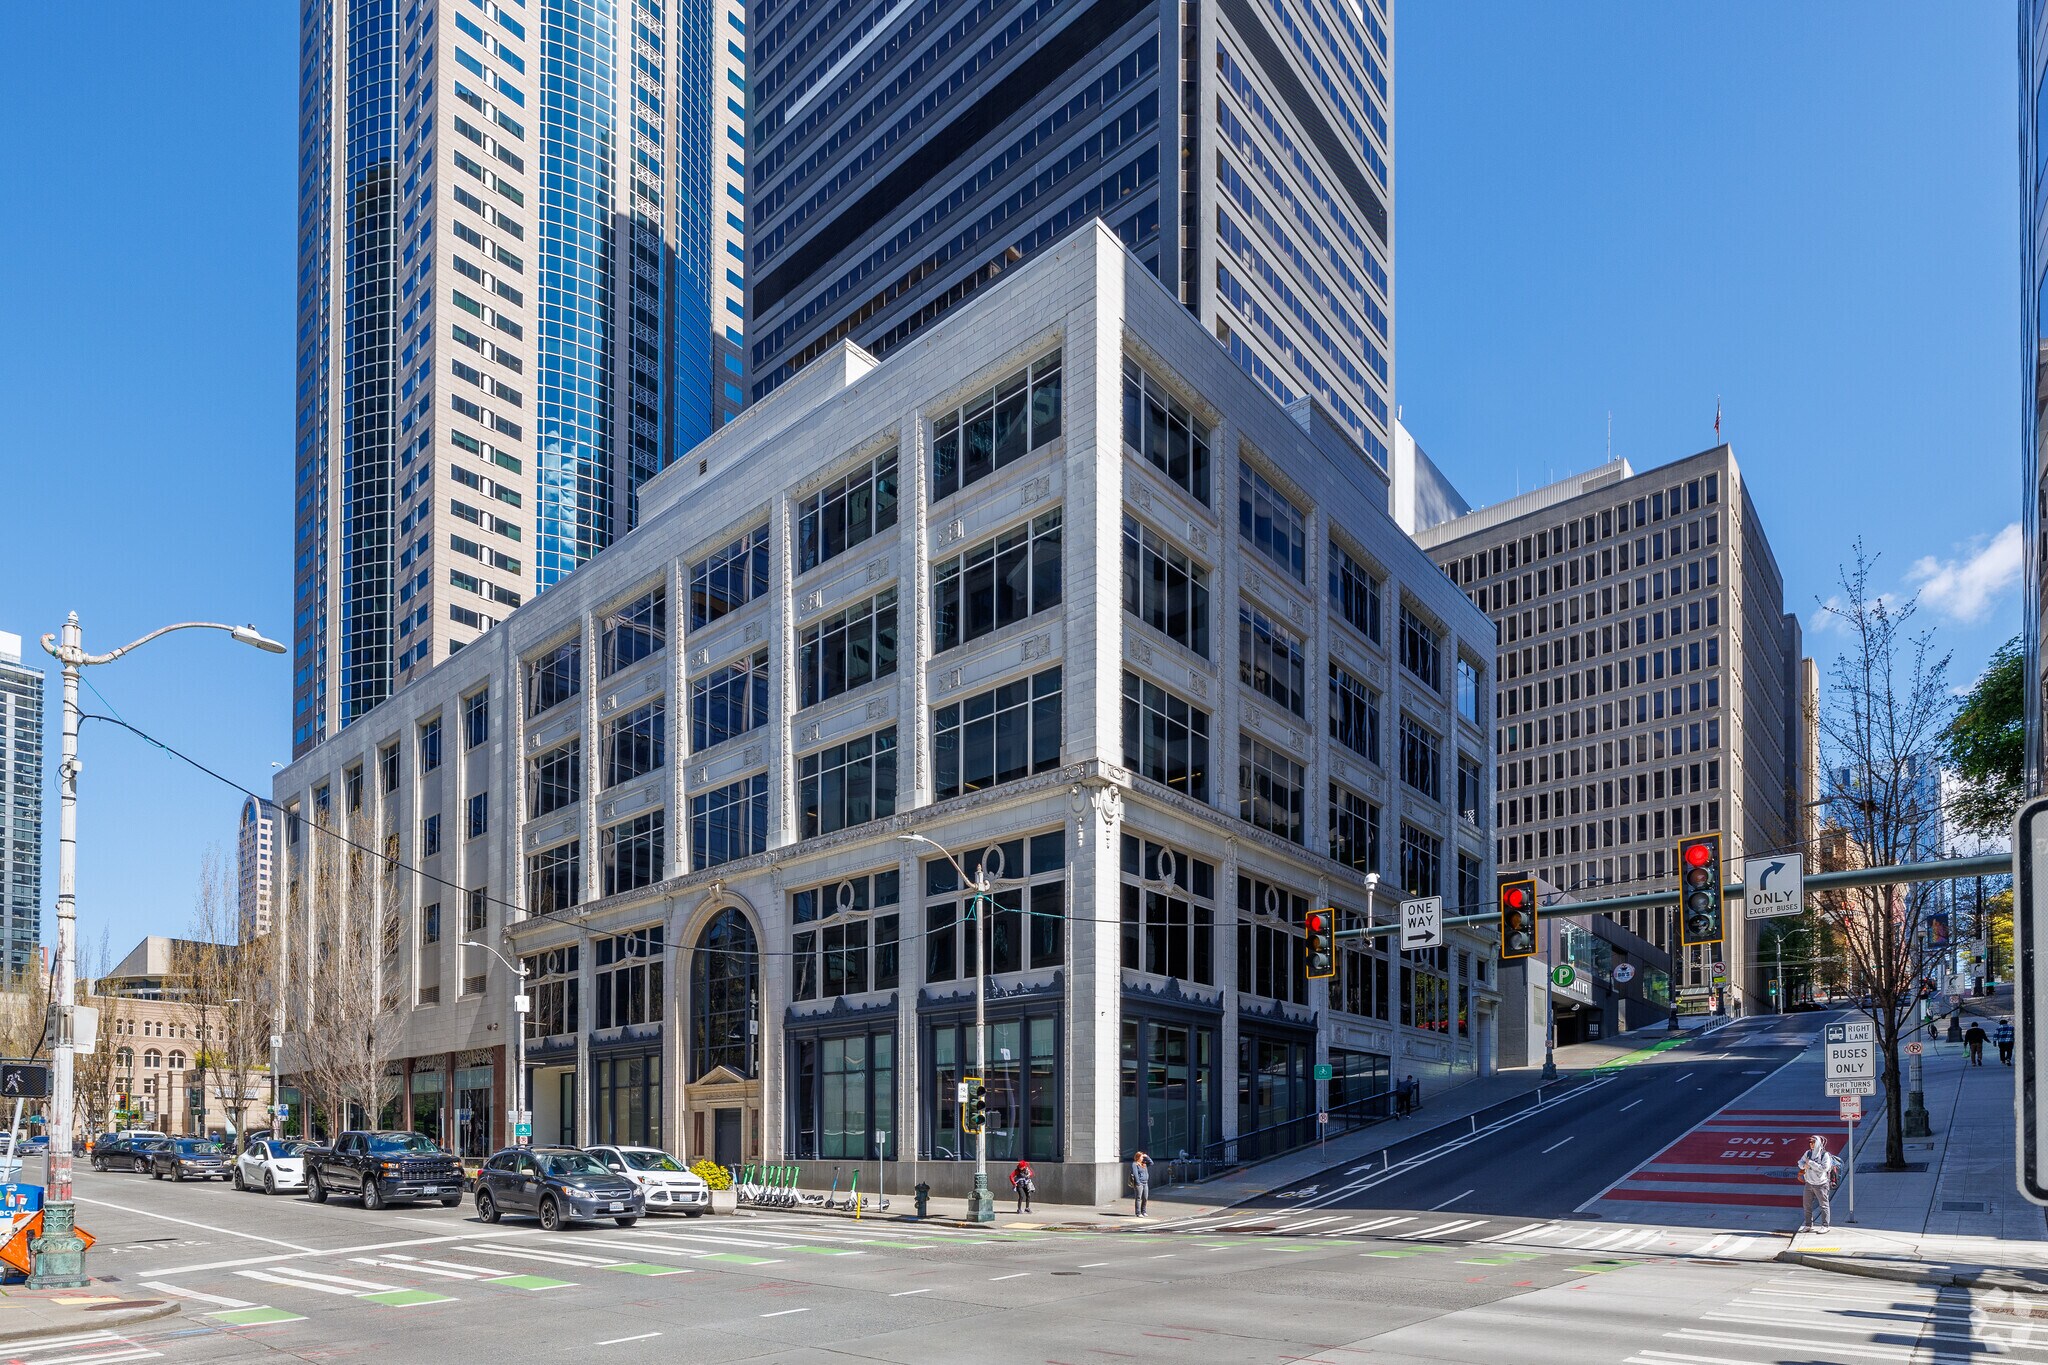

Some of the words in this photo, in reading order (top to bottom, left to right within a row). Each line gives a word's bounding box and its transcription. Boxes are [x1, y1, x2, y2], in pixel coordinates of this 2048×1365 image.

[1753, 890, 1793, 905] ONLY
[1408, 902, 1432, 915] ONE
[1749, 906, 1773, 915] EXCEPT
[1776, 903, 1798, 911] BUSES
[1408, 915, 1434, 928] WAY
[1558, 968, 1570, 984] P
[1848, 1024, 1870, 1032] RIGHT
[1849, 1032, 1869, 1040] LANE
[1832, 1048, 1868, 1059] BUSES
[1835, 1063, 1864, 1073] ONLY
[1829, 1081, 1848, 1089] RIGHT
[1832, 1087, 1868, 1095] PERMITTED
[1720, 1151, 1774, 1159] BUS
